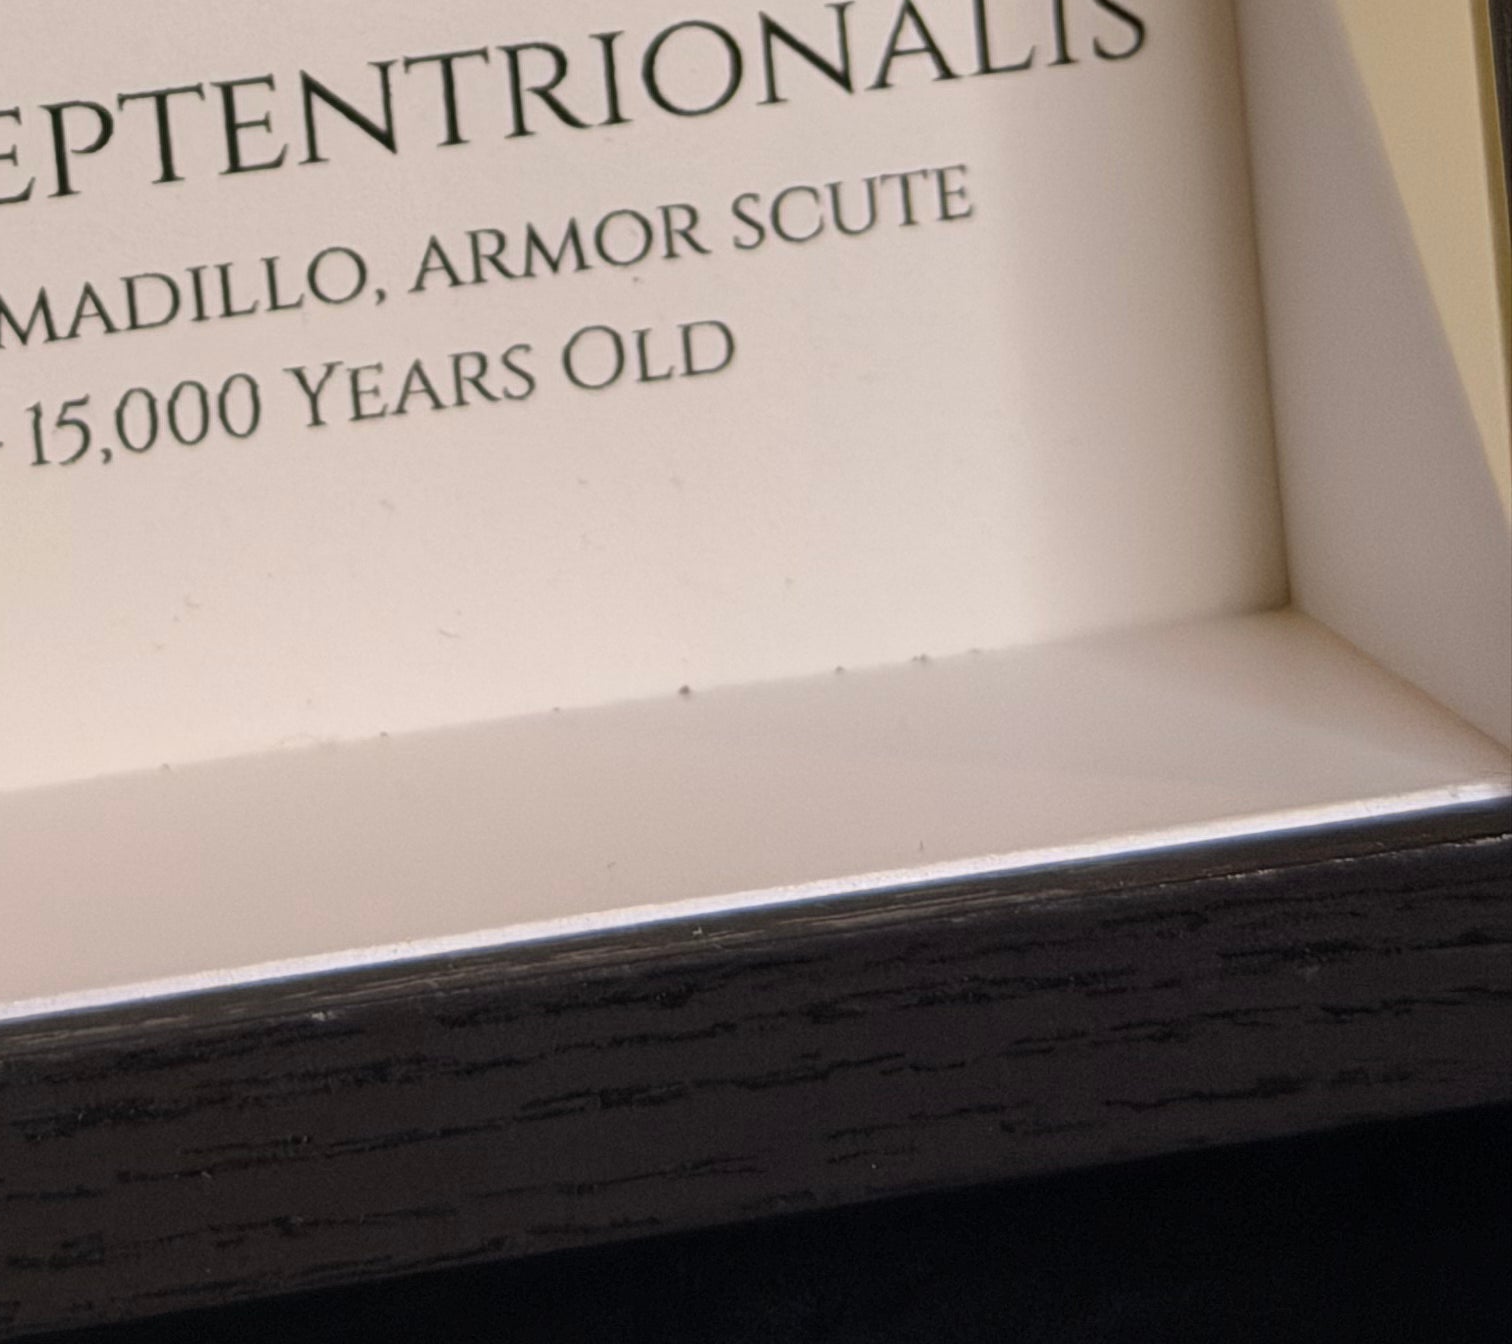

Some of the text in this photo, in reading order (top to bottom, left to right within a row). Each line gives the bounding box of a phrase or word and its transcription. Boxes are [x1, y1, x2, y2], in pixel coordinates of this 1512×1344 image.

[407, 203, 713, 294] ARMOR
[731, 164, 974, 251] SCUTE
[26, 372, 262, 467] 15,000
[282, 343, 537, 429] YEARS
[561, 319, 737, 392] OLD
